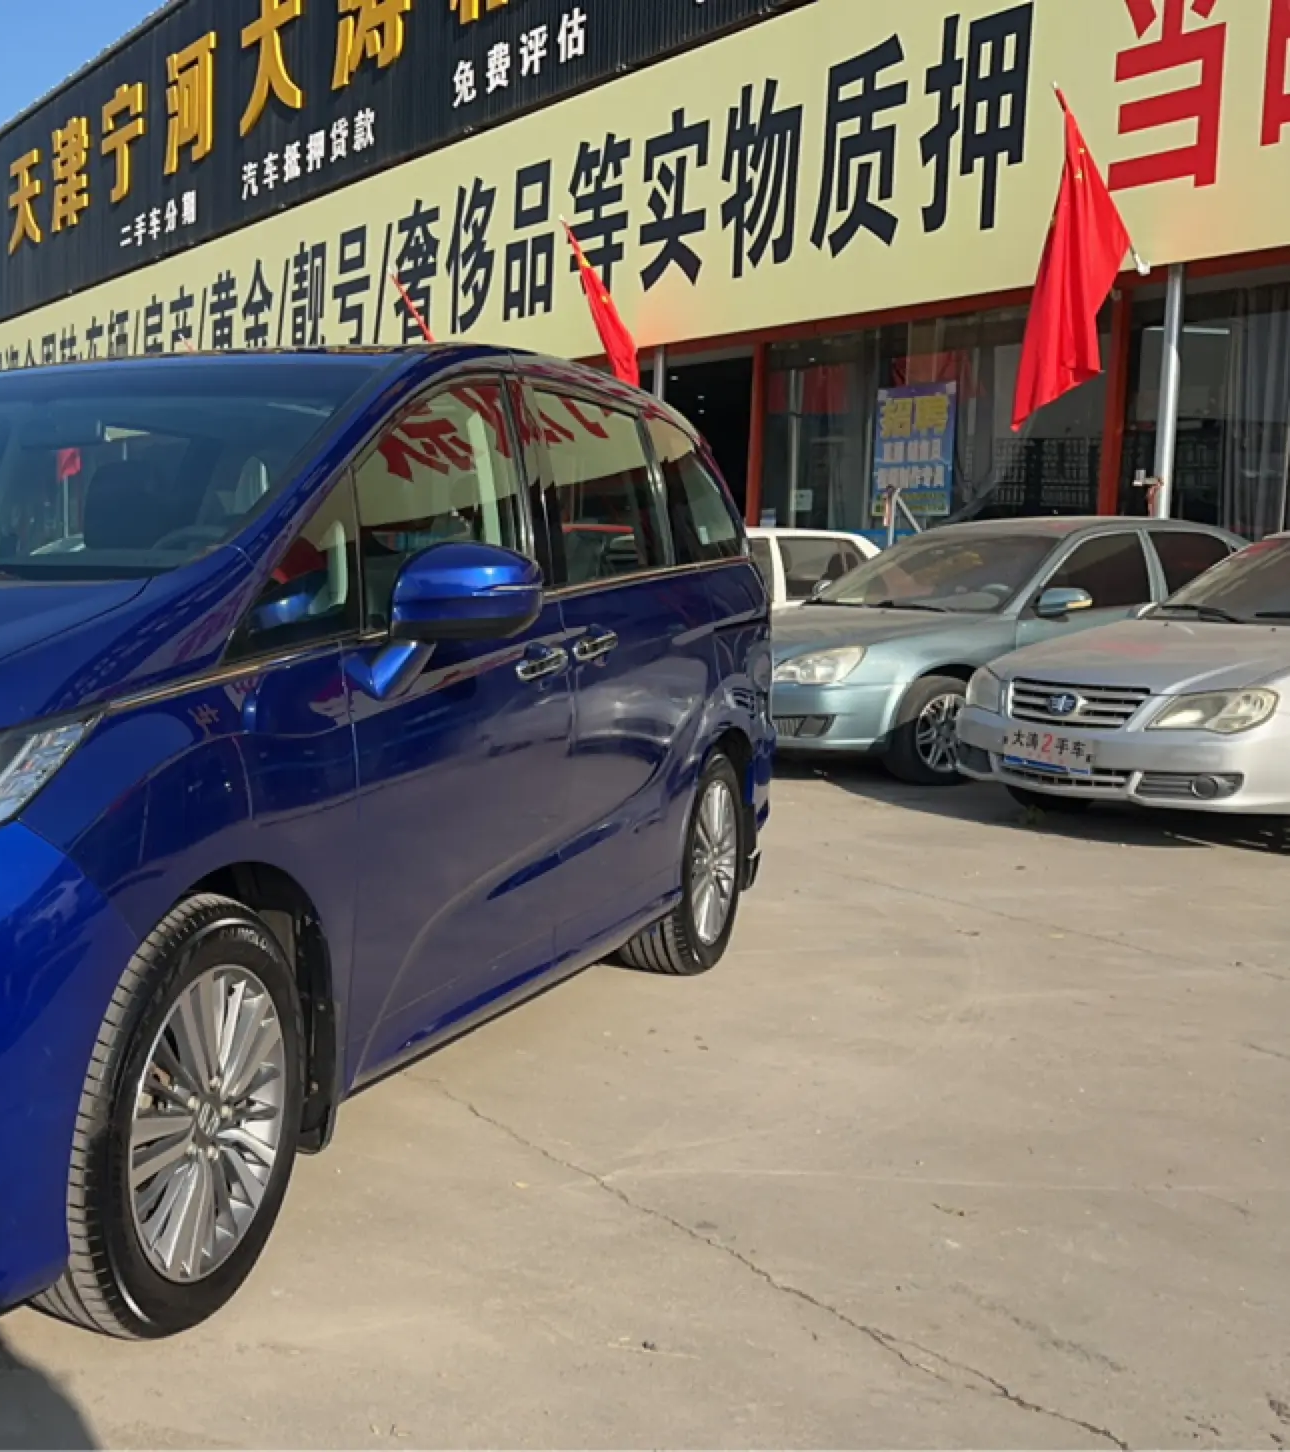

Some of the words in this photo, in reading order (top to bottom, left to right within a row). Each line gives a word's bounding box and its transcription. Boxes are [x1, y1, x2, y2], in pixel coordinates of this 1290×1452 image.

[8, 0, 504, 255] 天津宁河大
[119, 189, 197, 247] 二手车分期
[241, 108, 376, 200] 汽车抵押贷款
[452, 7, 587, 108] 免费评估
